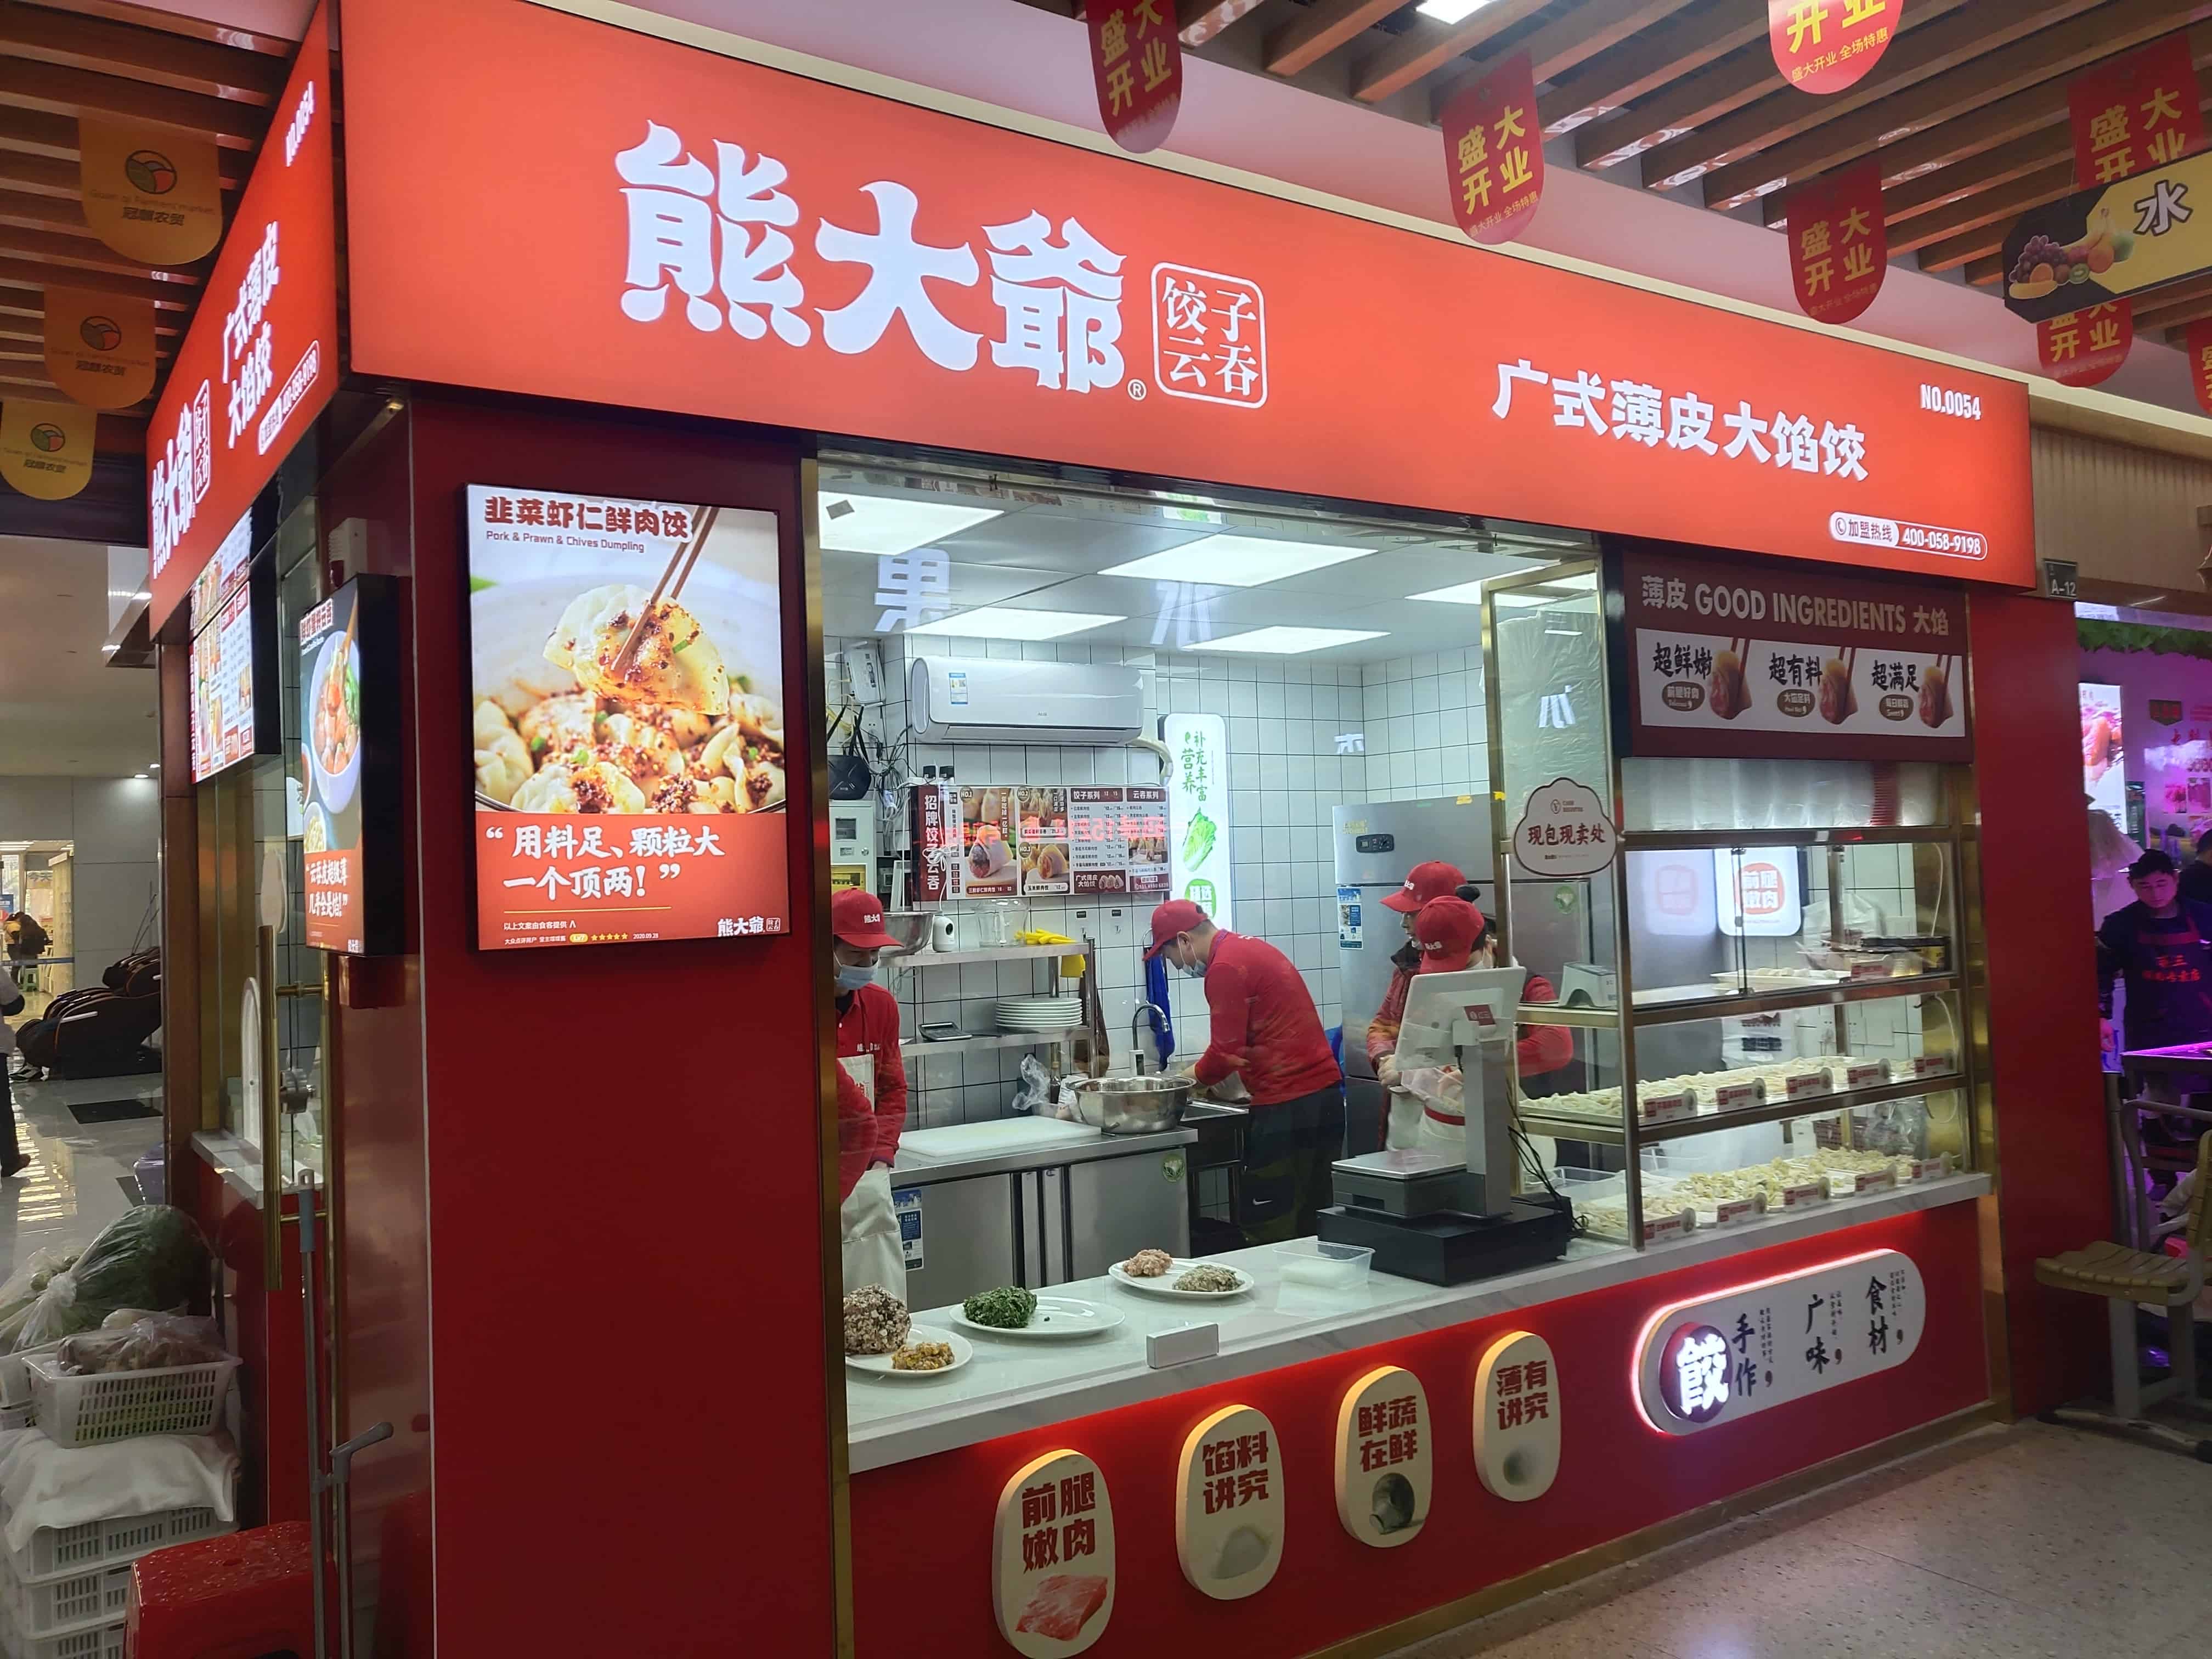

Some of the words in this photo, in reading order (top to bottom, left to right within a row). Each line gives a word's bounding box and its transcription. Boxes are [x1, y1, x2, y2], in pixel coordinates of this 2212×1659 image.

[1839, 27, 1889, 61] 全场特惠
[1107, 36, 1172, 117] 开业
[1458, 105, 1526, 174] 盛大
[1462, 145, 1533, 215] 开业
[2134, 179, 2193, 236] 水
[1801, 206, 1871, 261] 盛大
[1804, 242, 1876, 297] 开业
[1161, 275, 1257, 345] 饺子
[2050, 318, 2121, 363] 开业
[1491, 358, 1870, 482] 广式薄皮大馅饺
[1920, 382, 1982, 421] NO.0054
[485, 496, 689, 538] 韭菜虾仁鲜肉饺
[1847, 517, 1893, 543] 加盟热线
[1901, 526, 1982, 556] 400-058-9198
[487, 530, 510, 541] Pork
[512, 532, 520, 541] &
[523, 533, 554, 545] Prawn
[556, 535, 563, 545] &
[567, 535, 599, 548] Chives
[601, 539, 645, 554] Dumpling
[1641, 574, 1689, 612] 薄皮
[1695, 583, 1767, 621] GOOD
[1773, 592, 1906, 634] INGREDIENTS
[1913, 605, 1949, 637] 大馅
[2051, 579, 2076, 596] A-12
[1652, 642, 1712, 680] 超鲜嫩
[1768, 652, 1823, 687] 超有料
[1871, 659, 1920, 692] 超满足
[1073, 791, 1100, 800] 饺子系列
[1133, 791, 1159, 799] 云吞系列
[1528, 822, 1606, 845] 现包现卖处
[1805, 1294, 1831, 1374] 广味
[1865, 1275, 1889, 1355] 食材
[1732, 1312, 1758, 1397] 手作
[1497, 1359, 1548, 1398] 薄有
[1358, 1395, 1417, 1438] 鲜蔬
[1497, 1391, 1549, 1431] 讲究
[1202, 1430, 1269, 1477] 馅料
[1359, 1429, 1418, 1474] 在鲜
[1022, 1471, 1096, 1529] 前腿
[1203, 1469, 1269, 1515] 讲究
[1023, 1517, 1096, 1575] 嫩肉
